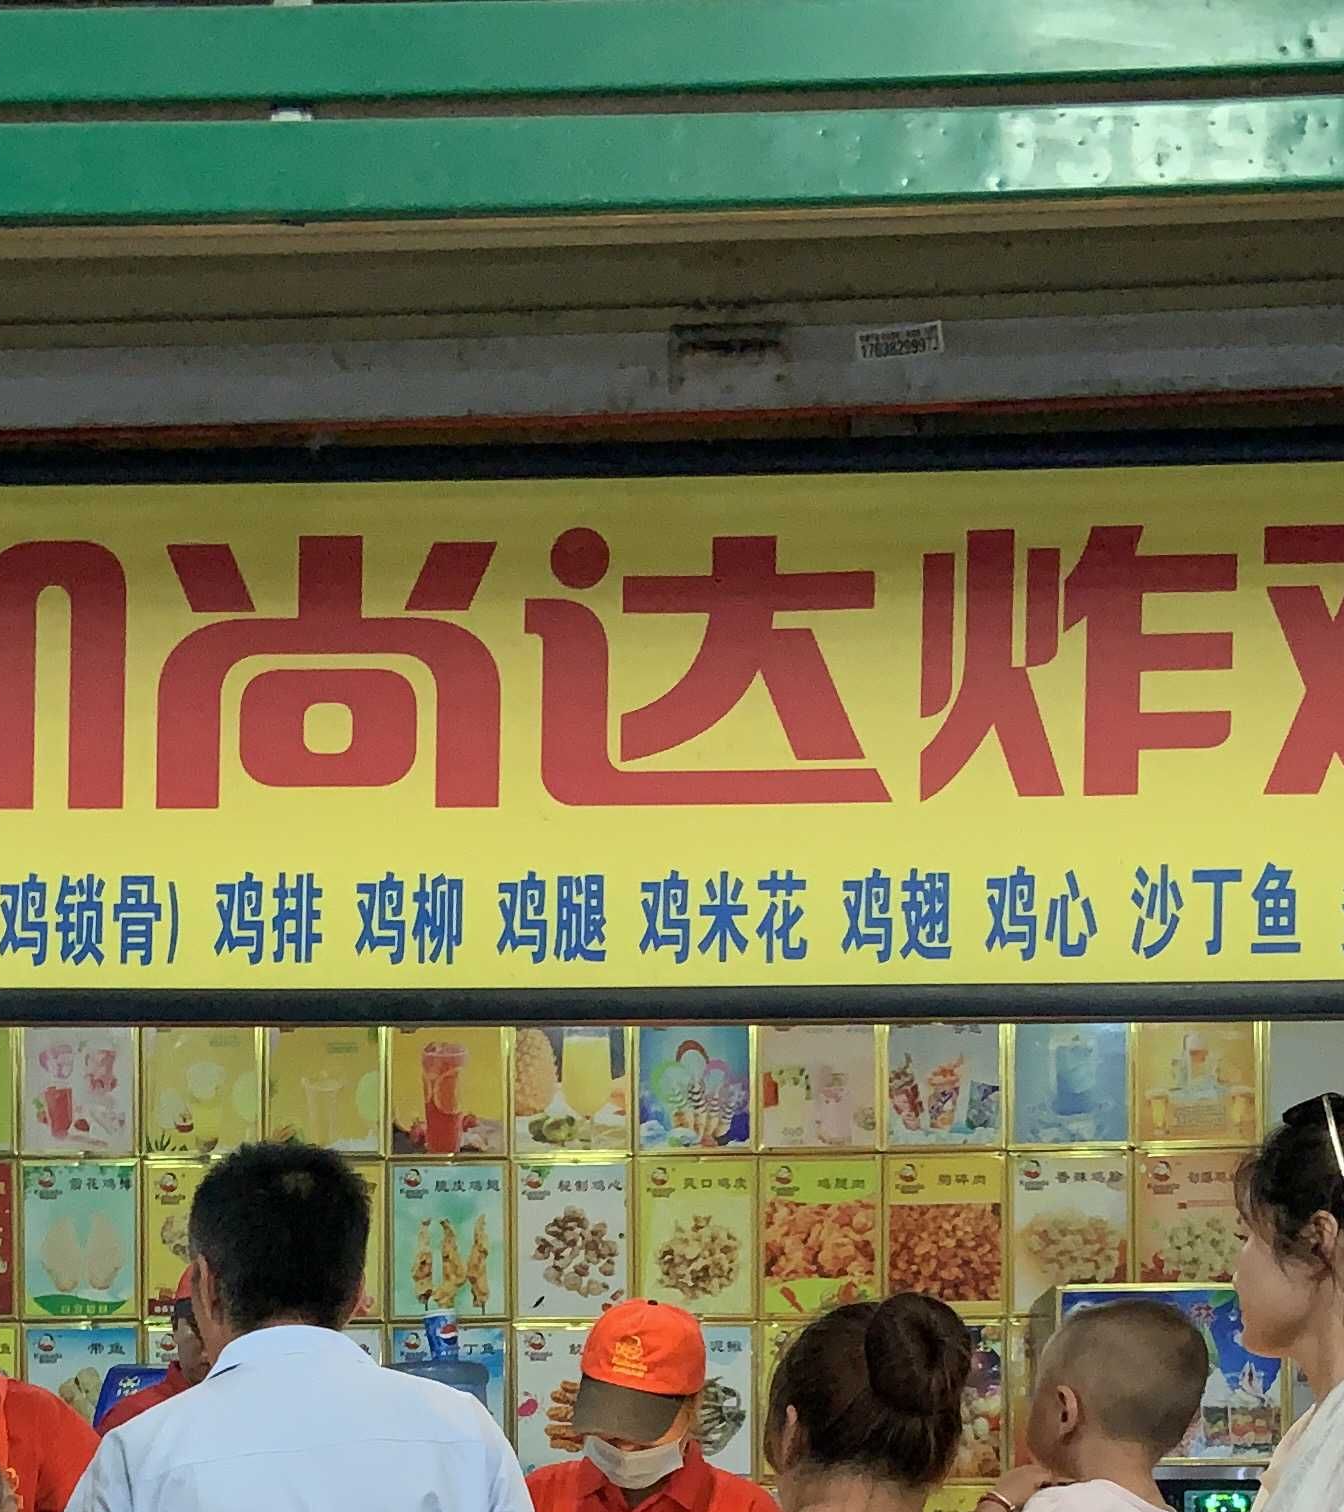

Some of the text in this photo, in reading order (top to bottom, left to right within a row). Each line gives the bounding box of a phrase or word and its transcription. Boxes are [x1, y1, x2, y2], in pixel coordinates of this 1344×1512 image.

[214, 871, 324, 966] 鸡排
[354, 871, 464, 966] 鸡柳
[496, 869, 607, 965] 鸡腿
[639, 867, 809, 964] 鸡米花
[841, 866, 953, 964] 鸡翅
[985, 865, 1098, 962] 鸡心
[1131, 862, 1303, 959] 沙丁鱼
